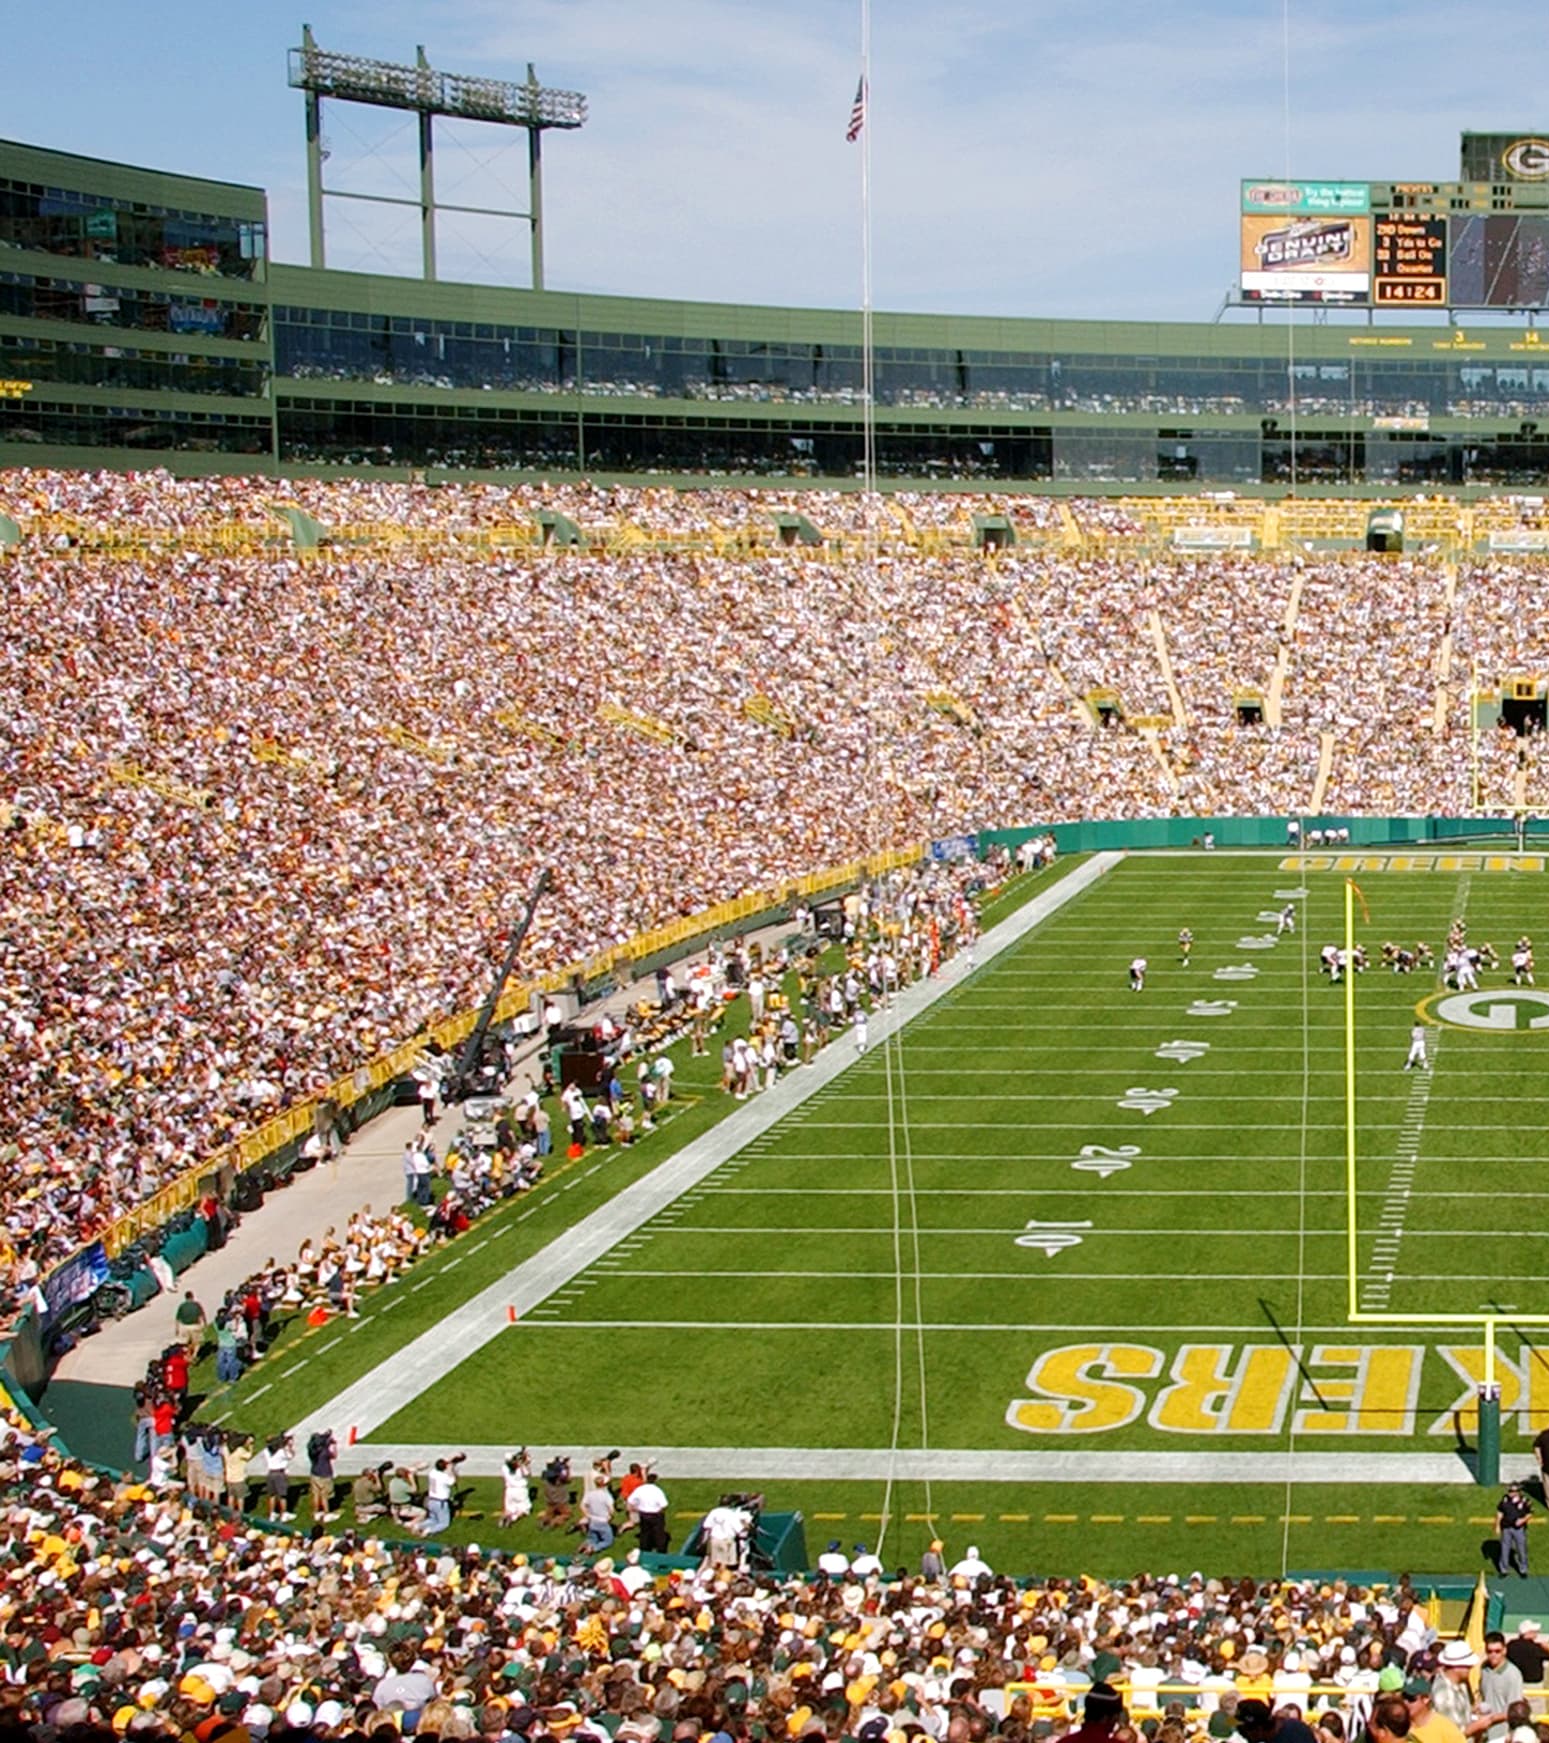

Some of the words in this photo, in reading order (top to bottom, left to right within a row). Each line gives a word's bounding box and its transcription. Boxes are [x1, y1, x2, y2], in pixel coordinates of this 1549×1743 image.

[1267, 240, 1344, 263] DRAFT
[1385, 285, 1436, 299] 14:24
[1454, 329, 1465, 343] 3
[1524, 331, 1540, 343] 14
[1278, 856, 1546, 873] GREEN
[1117, 1087, 1180, 1109] 30
[1070, 1145, 1142, 1171] 20
[1013, 1219, 1094, 1248] 10
